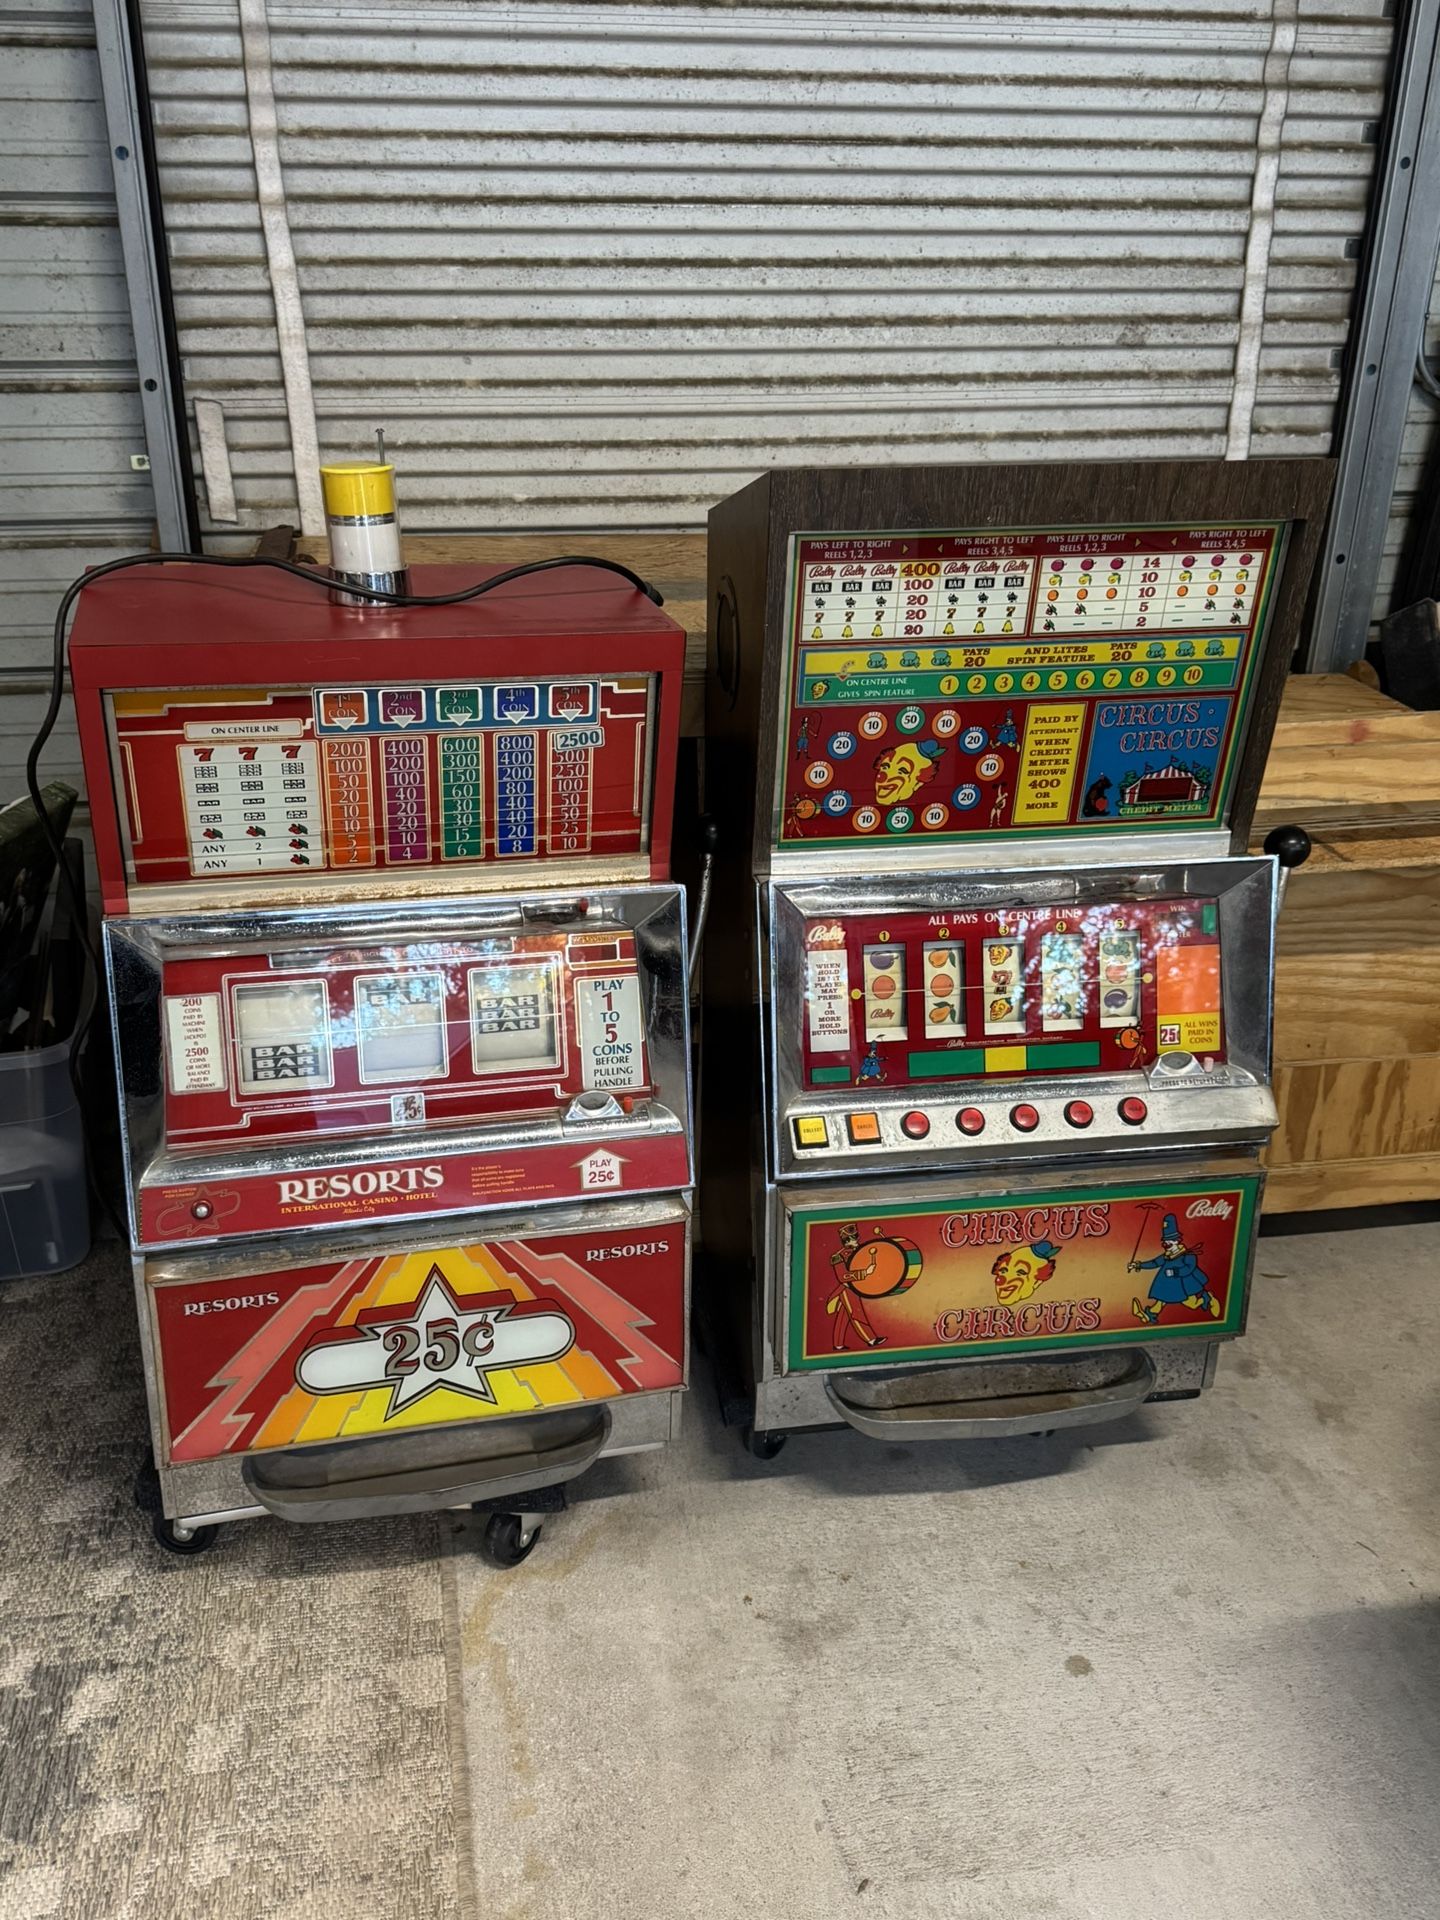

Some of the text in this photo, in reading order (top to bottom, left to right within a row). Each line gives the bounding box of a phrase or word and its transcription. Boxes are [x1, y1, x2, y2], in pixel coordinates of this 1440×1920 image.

[866, 540, 891, 548] RIGHT
[955, 537, 972, 545] PAYS
[974, 537, 1001, 545] RIGHT
[1047, 535, 1065, 543] PAYS
[1201, 539, 1246, 548] REELS 3,4,5
[968, 546, 1013, 555] REELS 3,4,5
[1060, 543, 1107, 552] REELS 1,2,3
[825, 550, 873, 559] REELS 1,2,3
[1143, 557, 1160, 568] 14
[902, 563, 940, 575] 400
[1141, 572, 1158, 583] 10
[904, 579, 933, 590] 100
[1138, 587, 1156, 598] 10
[907, 595, 928, 605] 20
[1139, 602, 1149, 612] 5
[906, 609, 926, 620] 20
[1136, 617, 1146, 626] 2
[904, 625, 923, 635] 20
[962, 648, 990, 656] PAYS
[1025, 646, 1088, 655] AND LITES
[1111, 651, 1132, 661] 20
[964, 657, 985, 667] 20
[1007, 654, 1095, 664] SPIN FEATURE
[861, 678, 889, 686] CENTRE
[838, 690, 861, 698] GIVES
[903, 715, 917, 724] 50
[1034, 716, 1061, 724] PAID
[1100, 703, 1200, 728] CIRCUS
[868, 721, 879, 730] 10
[942, 719, 952, 728] 10
[228, 726, 259, 734] CENTER
[444, 738, 477, 752] 600
[501, 736, 532, 750] 800
[559, 731, 600, 748] 2500
[836, 741, 849, 749] 20
[967, 735, 980, 744] 20
[1120, 727, 1219, 753] CIRCUS
[238, 747, 258, 760] 7
[281, 745, 301, 758] 7
[331, 743, 363, 757] 200
[387, 741, 421, 755] 400
[1029, 748, 1072, 756] CREDIT
[193, 748, 214, 761] 7
[501, 751, 532, 765] 400
[556, 749, 585, 763] 500
[334, 759, 362, 772] 100
[389, 757, 421, 770] 200
[445, 754, 477, 767] 300
[555, 764, 584, 778] 250
[986, 763, 996, 771] 10
[1028, 768, 1066, 776] SHOWS
[392, 772, 421, 785] 100
[449, 770, 476, 783] 150
[503, 767, 532, 781] 200
[813, 770, 825, 779] 10
[338, 775, 359, 789] 50
[558, 779, 583, 792] 100
[1028, 779, 1061, 789] 400
[452, 785, 473, 798] 60
[506, 782, 526, 794] 80
[339, 790, 359, 803] 20
[395, 787, 416, 801] 40
[961, 792, 974, 801] 20
[831, 799, 845, 807] 20
[1025, 802, 1059, 810] MORE
[1120, 804, 1202, 814] CREDIT METER
[862, 815, 872, 824] 10
[893, 815, 907, 825] 50
[930, 812, 940, 821] 10
[202, 843, 262, 854] ANY 2
[203, 860, 227, 870] ANY
[928, 916, 947, 926] ALL
[953, 914, 978, 924] PAYS
[1008, 910, 1052, 922] CENTRE
[1056, 908, 1081, 919] LINE
[808, 925, 846, 944] Bally
[881, 932, 887, 941] 1
[941, 930, 947, 938] 2
[594, 980, 624, 991] PLAY
[182, 998, 202, 1007] 200
[602, 992, 612, 1011] 1
[600, 1012, 620, 1022] TO
[605, 1024, 617, 1043] 5
[185, 1047, 209, 1057] 2500
[255, 1044, 314, 1057] BAR
[592, 1043, 632, 1056] COINS
[256, 1056, 314, 1068] BAR
[595, 1057, 629, 1065] BEFORE
[257, 1068, 315, 1080] BAR
[594, 1067, 633, 1077] PULLING
[594, 1078, 632, 1087] HANDLE
[590, 1158, 612, 1168] PLAY
[589, 1171, 614, 1184] 25¢
[278, 1165, 444, 1204] RESORTS
[281, 1192, 438, 1214] INTERNATIONAL CASINO HOTEL
[1185, 1199, 1234, 1220] Bally
[941, 1204, 1109, 1248] CIRCUS
[586, 1240, 669, 1262] RESORTS
[184, 1292, 280, 1316] RESORTS
[935, 1298, 1101, 1343] CIRCUS
[383, 1314, 494, 1377] 25¢
